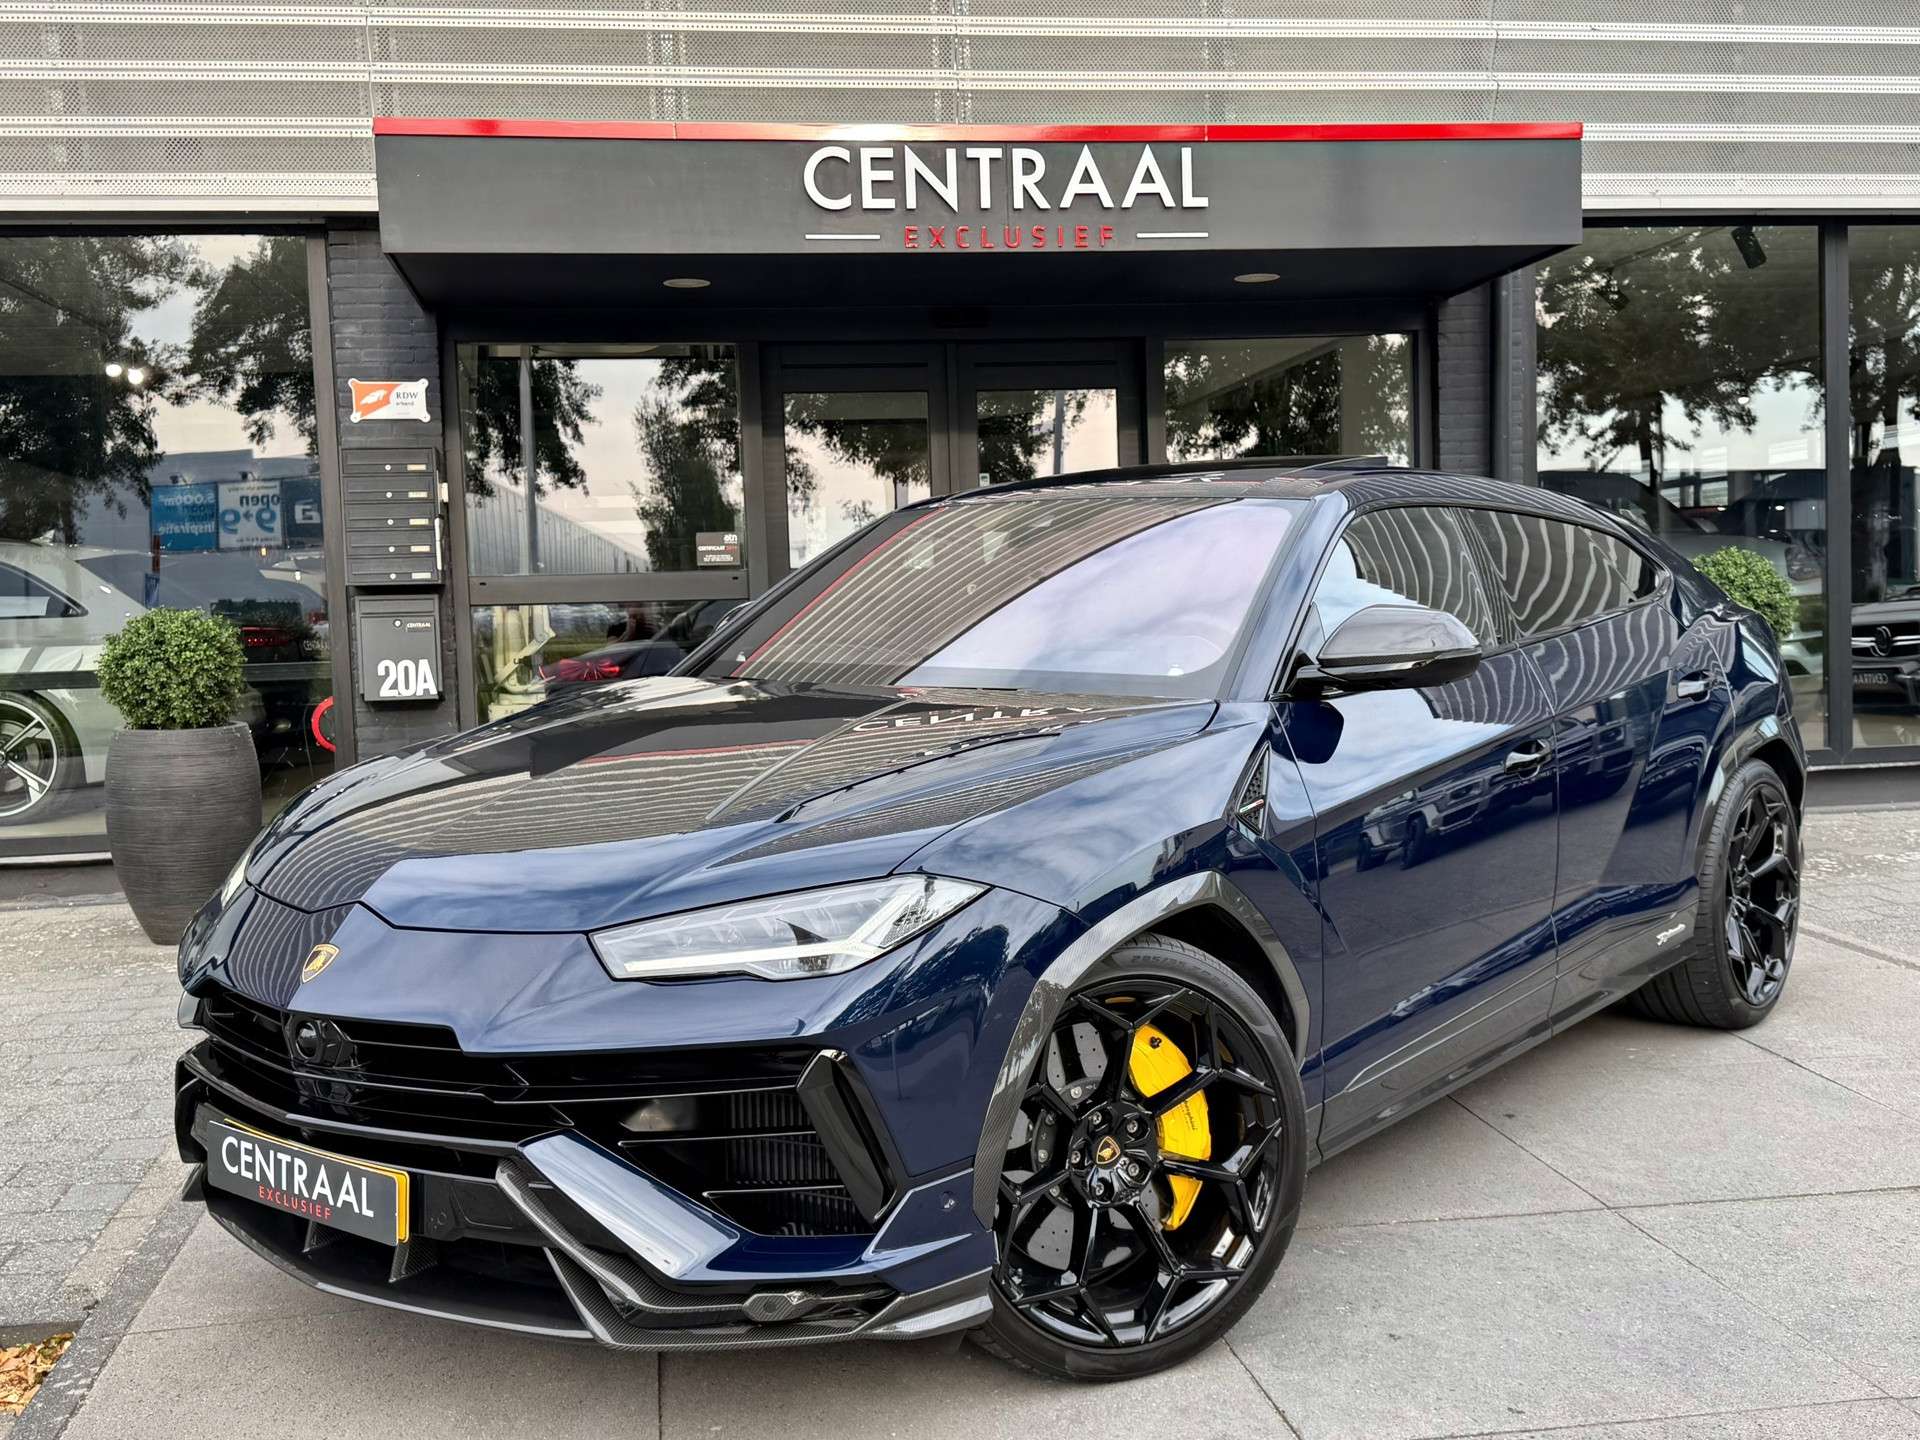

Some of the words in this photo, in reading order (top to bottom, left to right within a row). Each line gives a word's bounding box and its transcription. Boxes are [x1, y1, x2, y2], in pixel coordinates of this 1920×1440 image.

[803, 143, 1209, 213] CENTRAAL
[903, 224, 1116, 249] EXCLUSIEF
[396, 391, 418, 400] RDW
[377, 658, 438, 697] 20A
[221, 1136, 374, 1218] CENTRAAL
[258, 1184, 333, 1221] EXCLUSIEF
